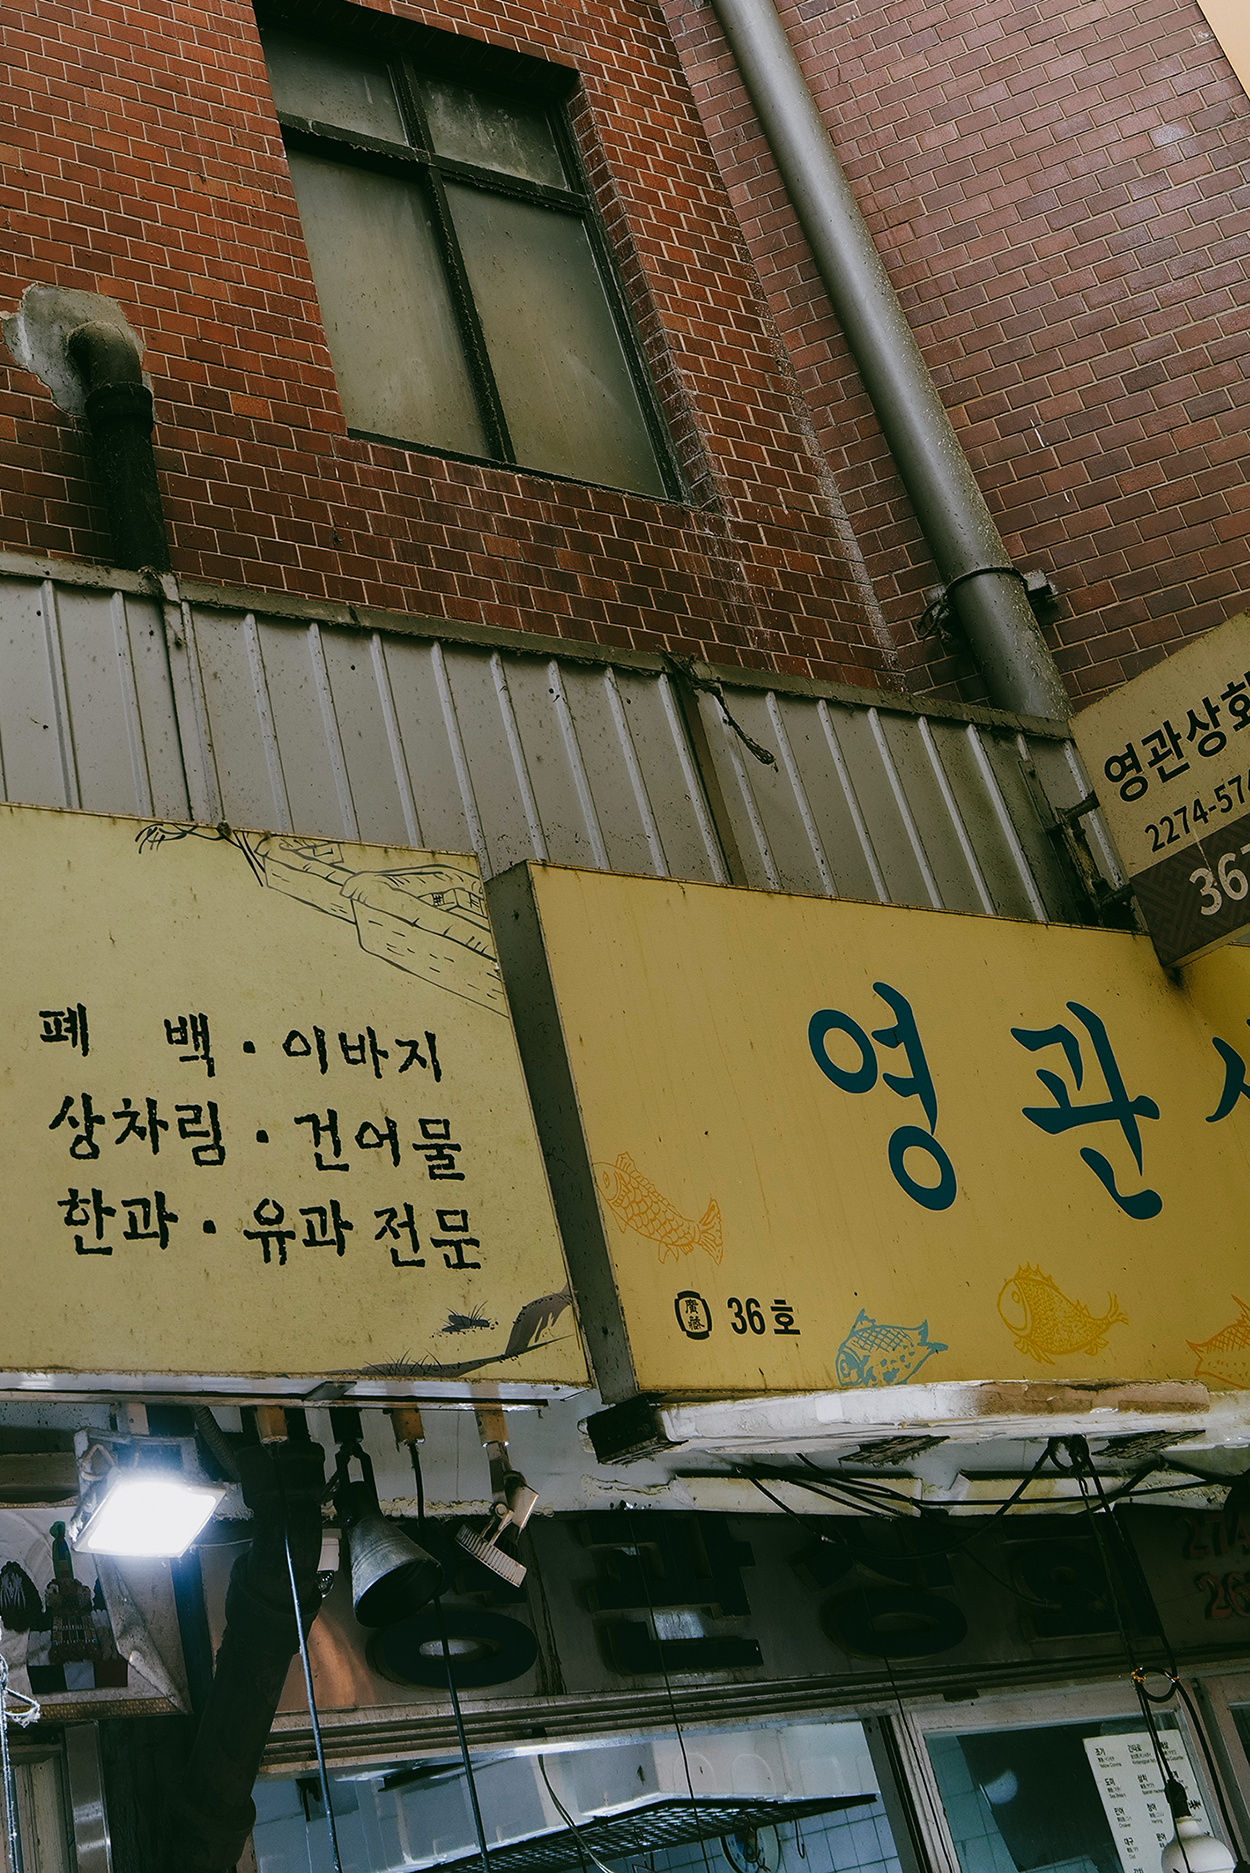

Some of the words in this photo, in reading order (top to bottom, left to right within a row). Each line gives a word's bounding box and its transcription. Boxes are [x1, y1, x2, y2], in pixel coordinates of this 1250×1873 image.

[1144, 769, 1250, 854] 2274-57
[1189, 844, 1250, 916] 36
[282, 1023, 444, 1083] 이바지
[47, 1092, 227, 1168] 상차림
[293, 1107, 467, 1183] 건어물
[57, 1188, 180, 1257] 한과
[242, 1197, 355, 1267] 유과
[372, 1202, 484, 1271] 전문
[726, 1296, 802, 1336] 36호
